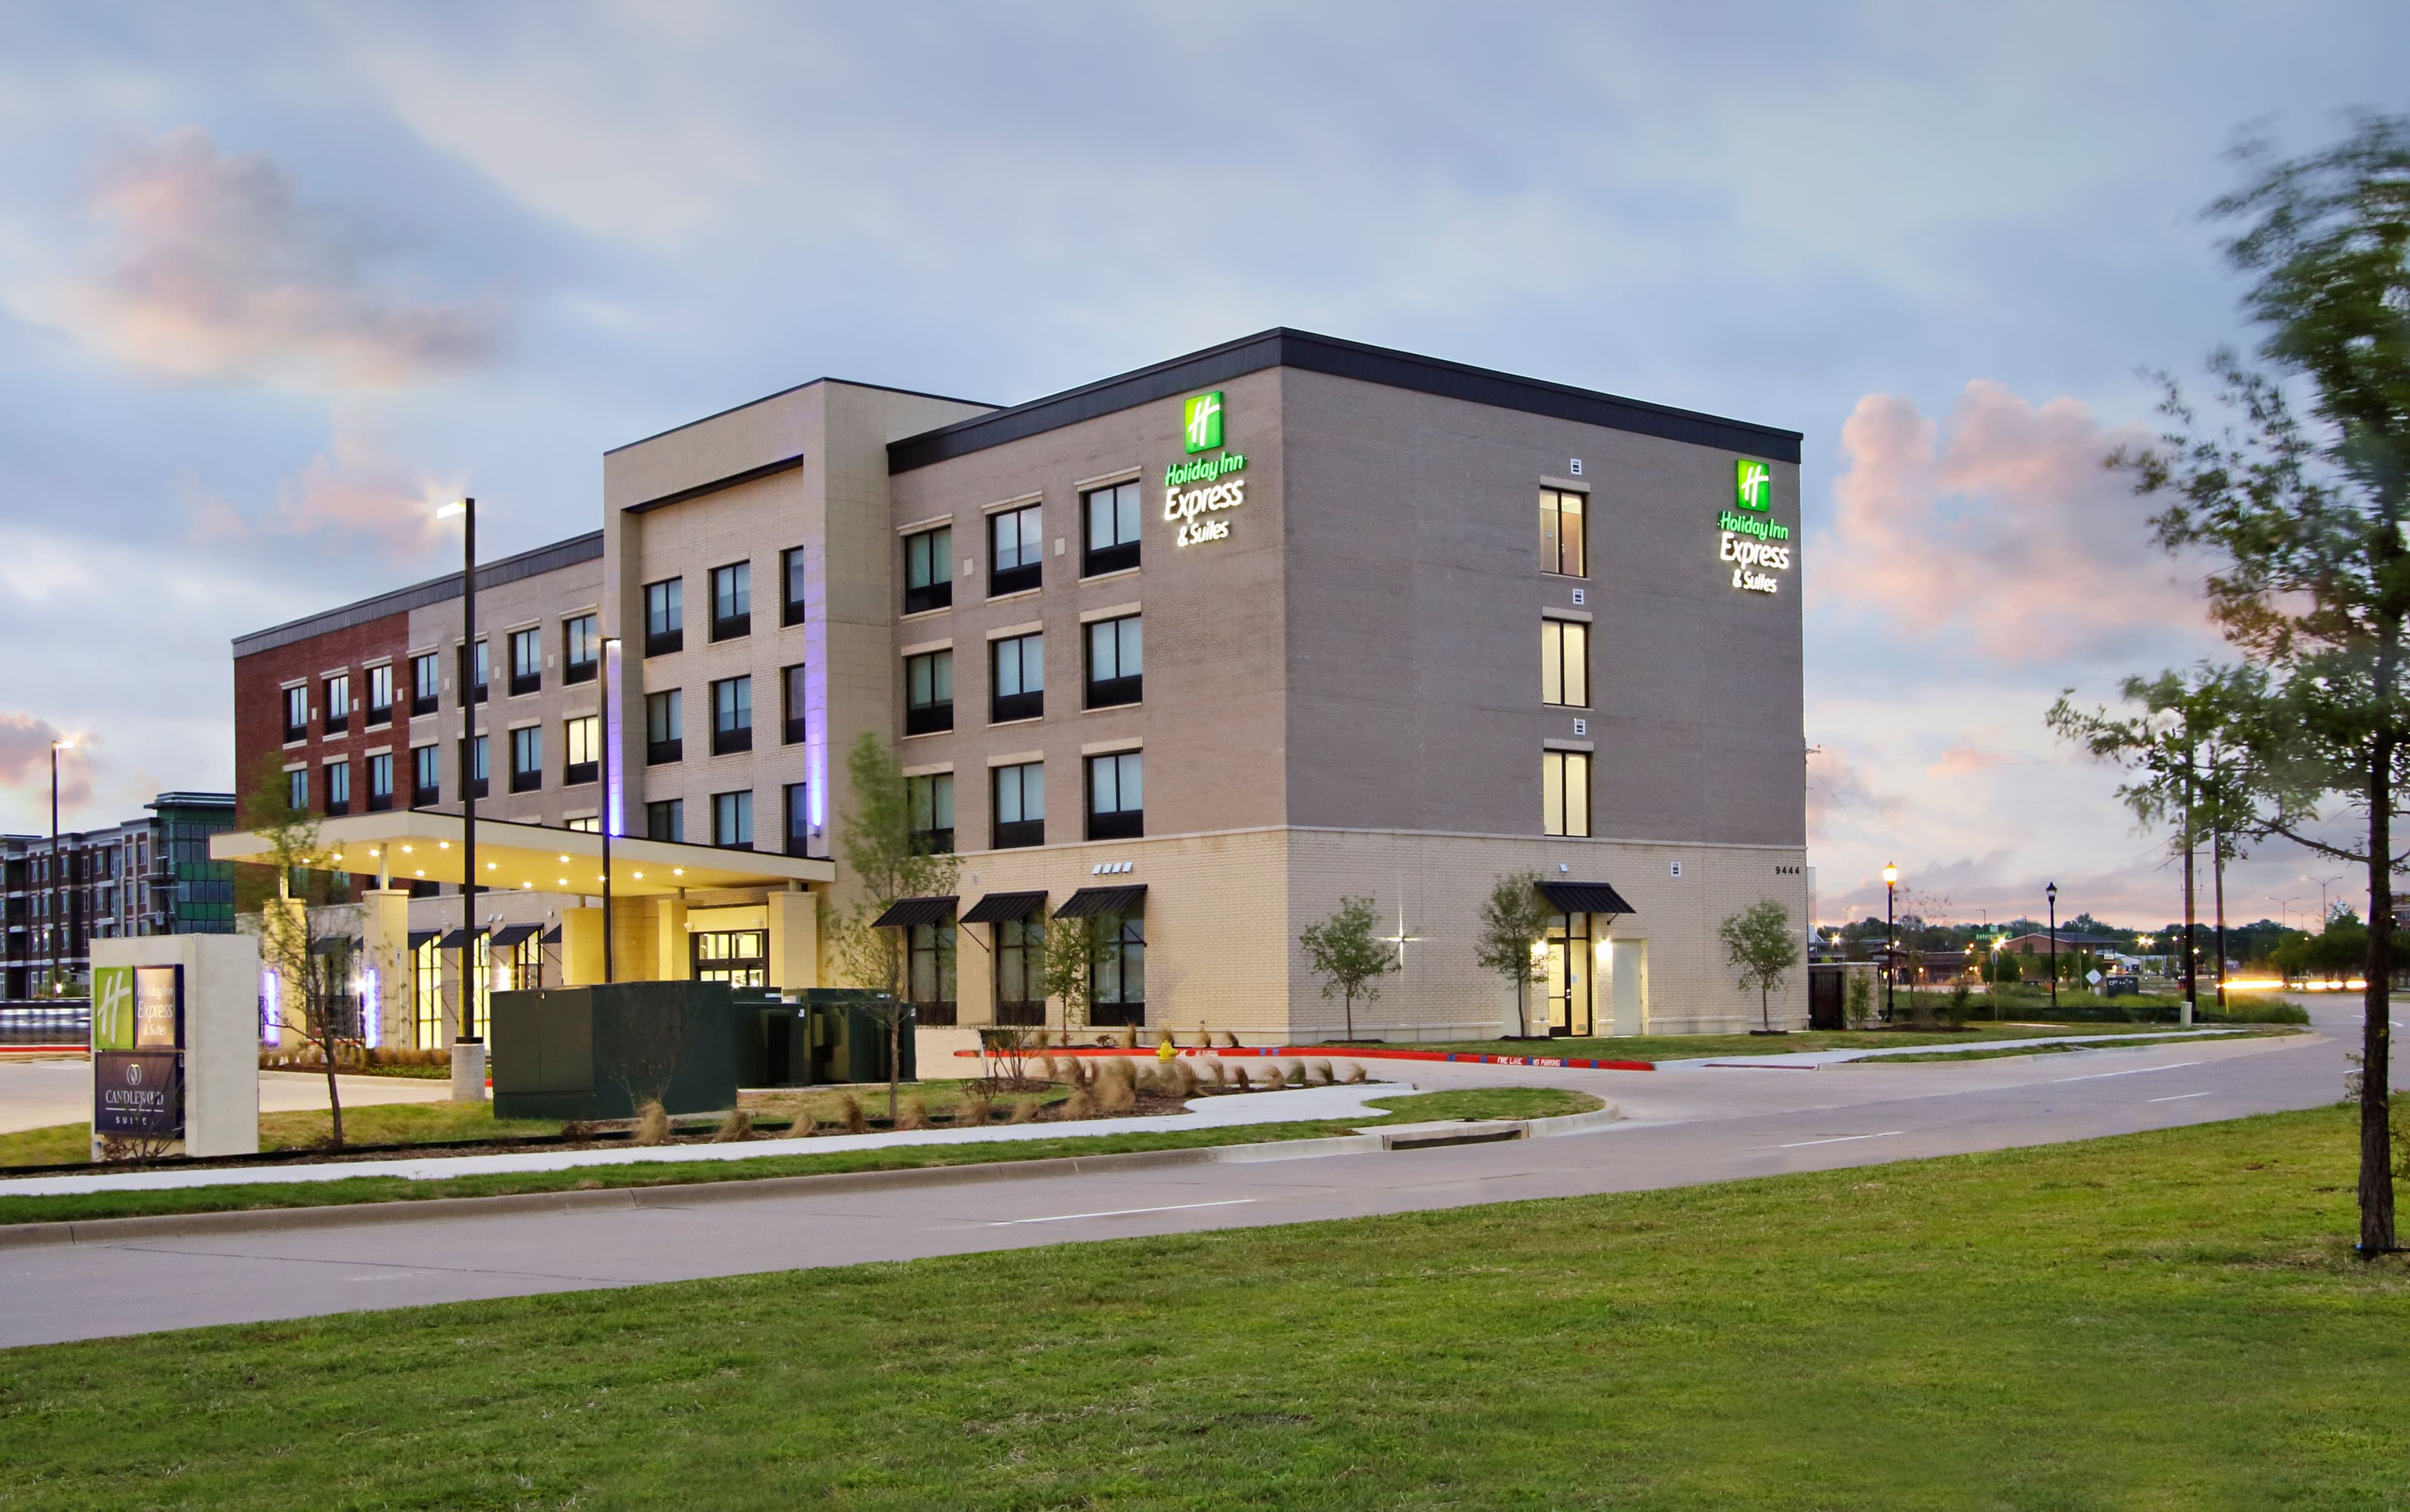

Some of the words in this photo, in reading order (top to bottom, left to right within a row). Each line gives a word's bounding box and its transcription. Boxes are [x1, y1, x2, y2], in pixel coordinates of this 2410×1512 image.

[1165, 458, 1219, 486] Holiday
[1219, 451, 1245, 474] Inn
[1164, 480, 1245, 524] Express
[1177, 526, 1189, 547] &
[1190, 520, 1229, 545] Suites
[1720, 510, 1768, 541] Holiday
[1769, 518, 1789, 540] Inn
[1720, 532, 1789, 570] Express
[1732, 569, 1742, 588] &
[1743, 571, 1777, 593] Suites
[1775, 866, 1800, 875] 9444
[163, 984, 173, 997] Inn
[138, 1000, 173, 1023] Express
[1509, 1057, 1523, 1065] LANE
[1540, 1059, 1560, 1067] PARKING
[115, 1117, 154, 1125] SUIE
